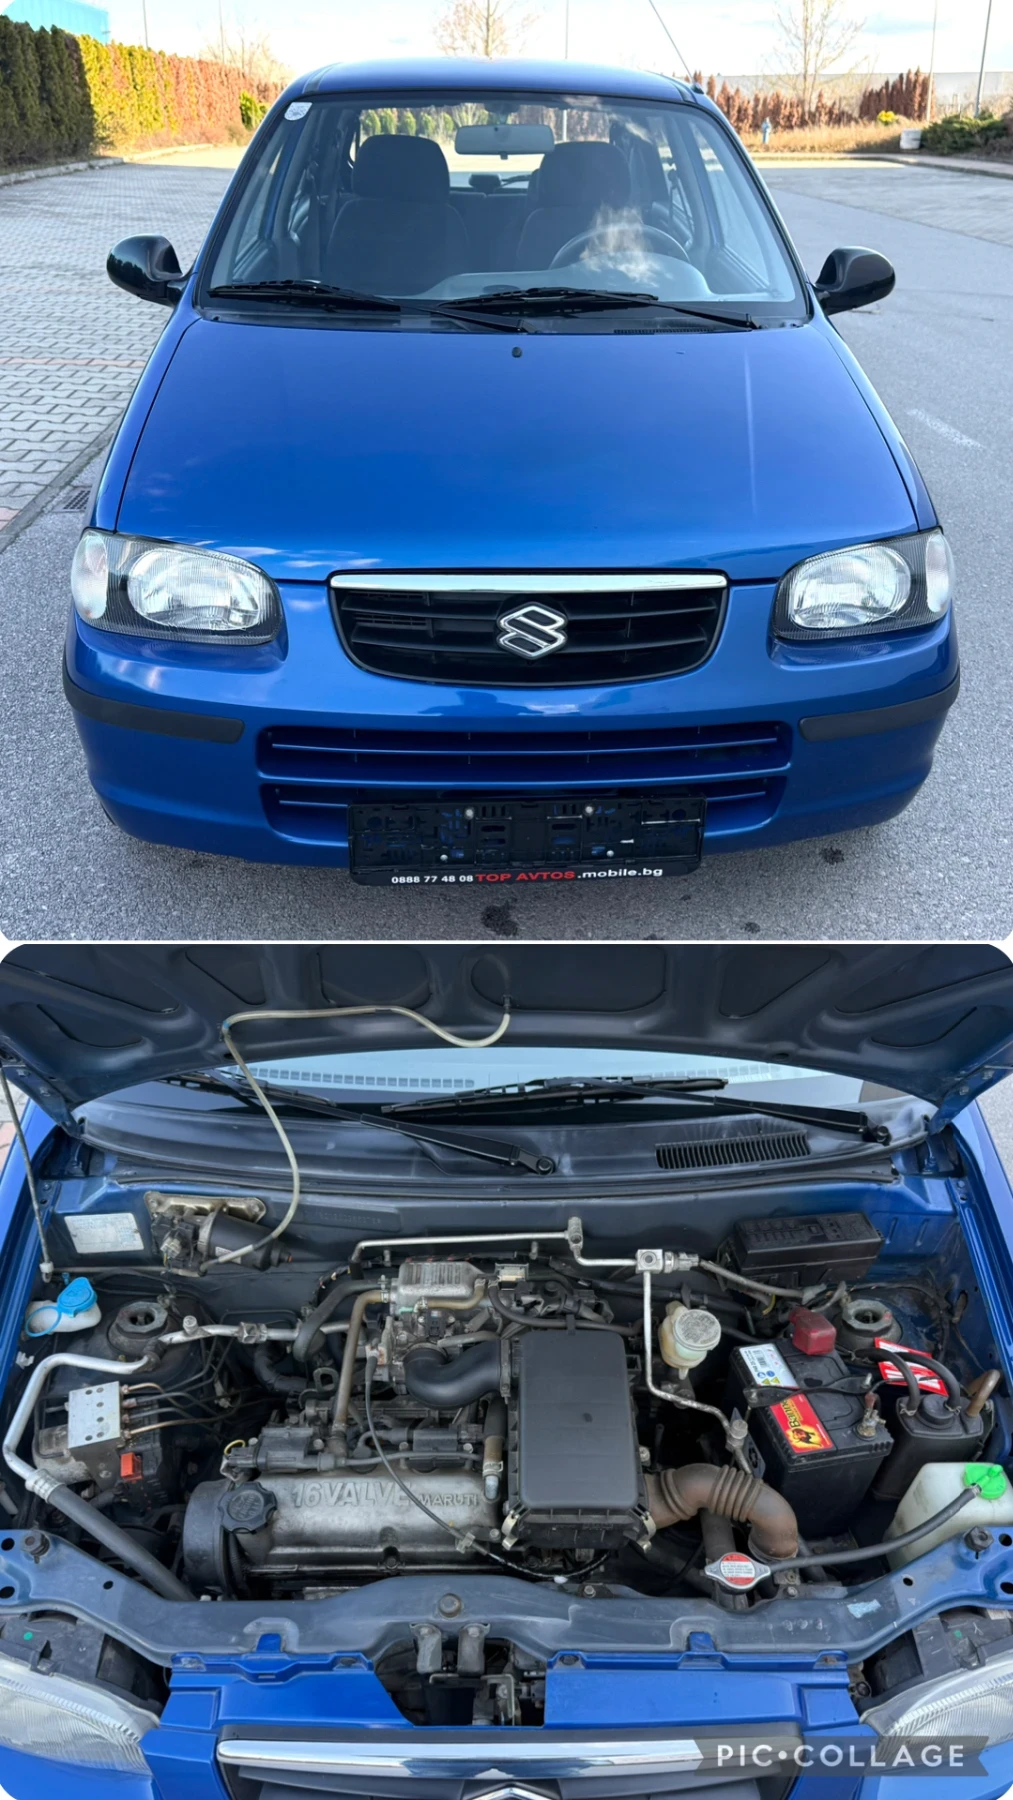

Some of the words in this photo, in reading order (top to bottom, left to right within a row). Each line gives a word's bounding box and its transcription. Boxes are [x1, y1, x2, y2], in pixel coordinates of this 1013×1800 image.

[391, 876, 420, 884] 0888
[424, 875, 438, 883] 77
[441, 875, 456, 883] 48
[459, 874, 474, 883] 08
[475, 873, 512, 882] TOP
[516, 871, 576, 880] AVTOS
[577, 868, 663, 879] .mobile.bg
[418, 1493, 480, 1507] MARUTI
